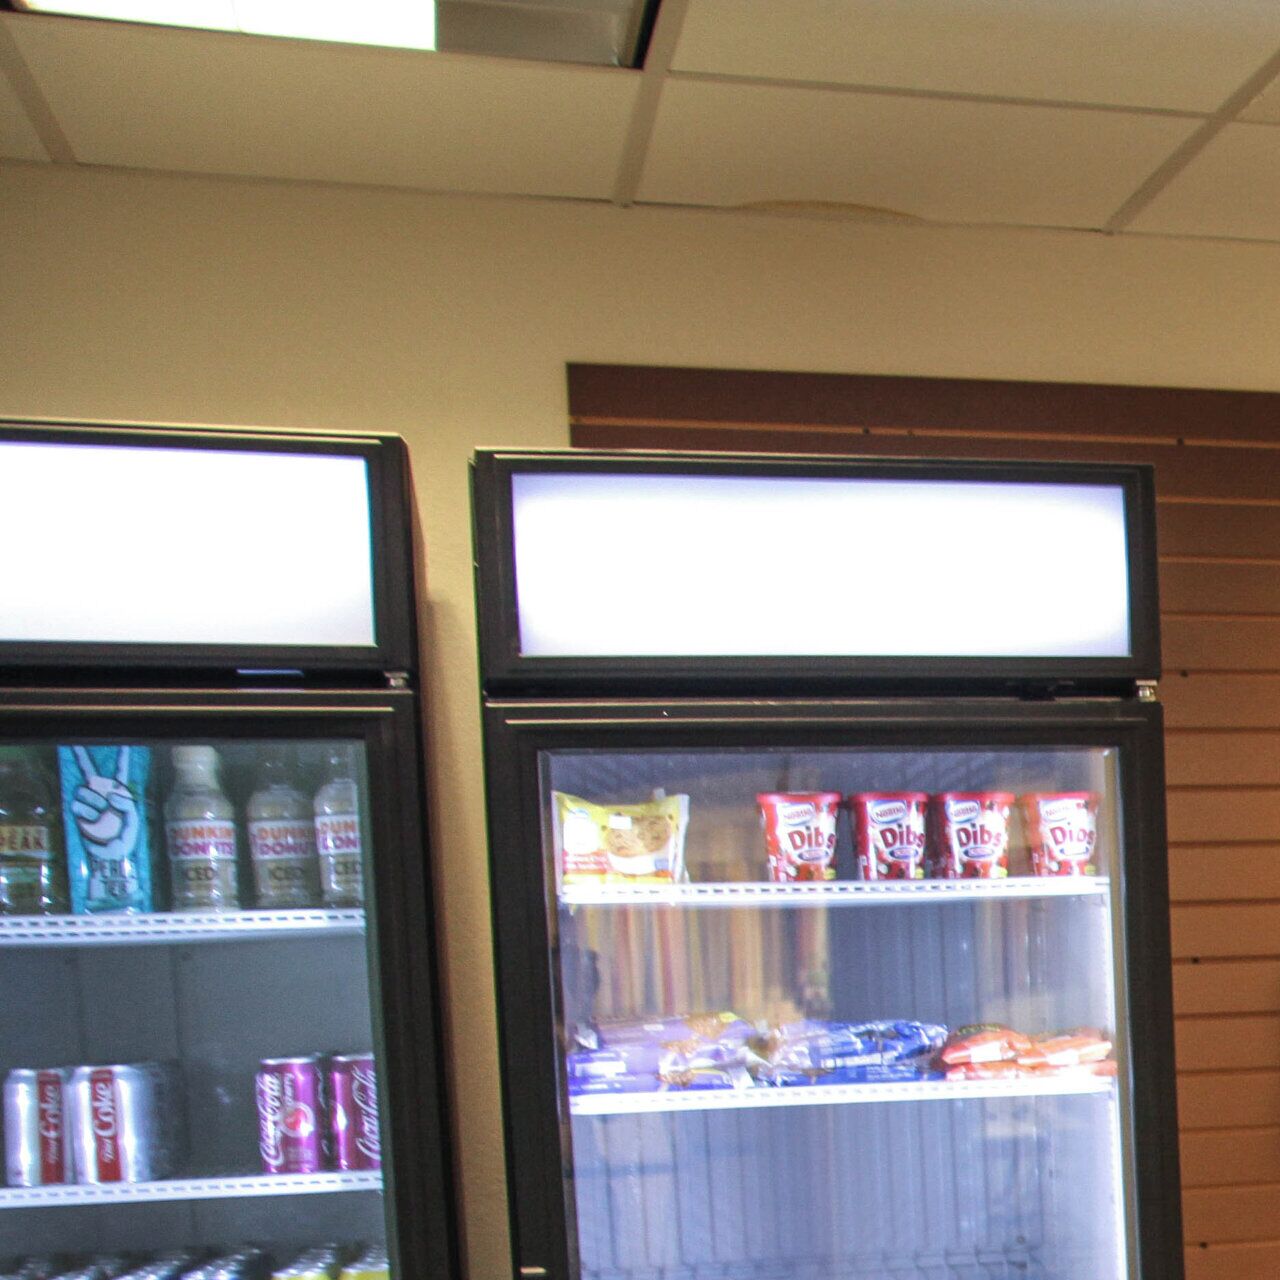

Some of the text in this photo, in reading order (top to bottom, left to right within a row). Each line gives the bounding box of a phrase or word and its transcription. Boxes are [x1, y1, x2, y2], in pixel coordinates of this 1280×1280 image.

[788, 825, 837, 851] Dibs
[879, 824, 927, 850] Dibs
[956, 823, 1002, 848] Dibs
